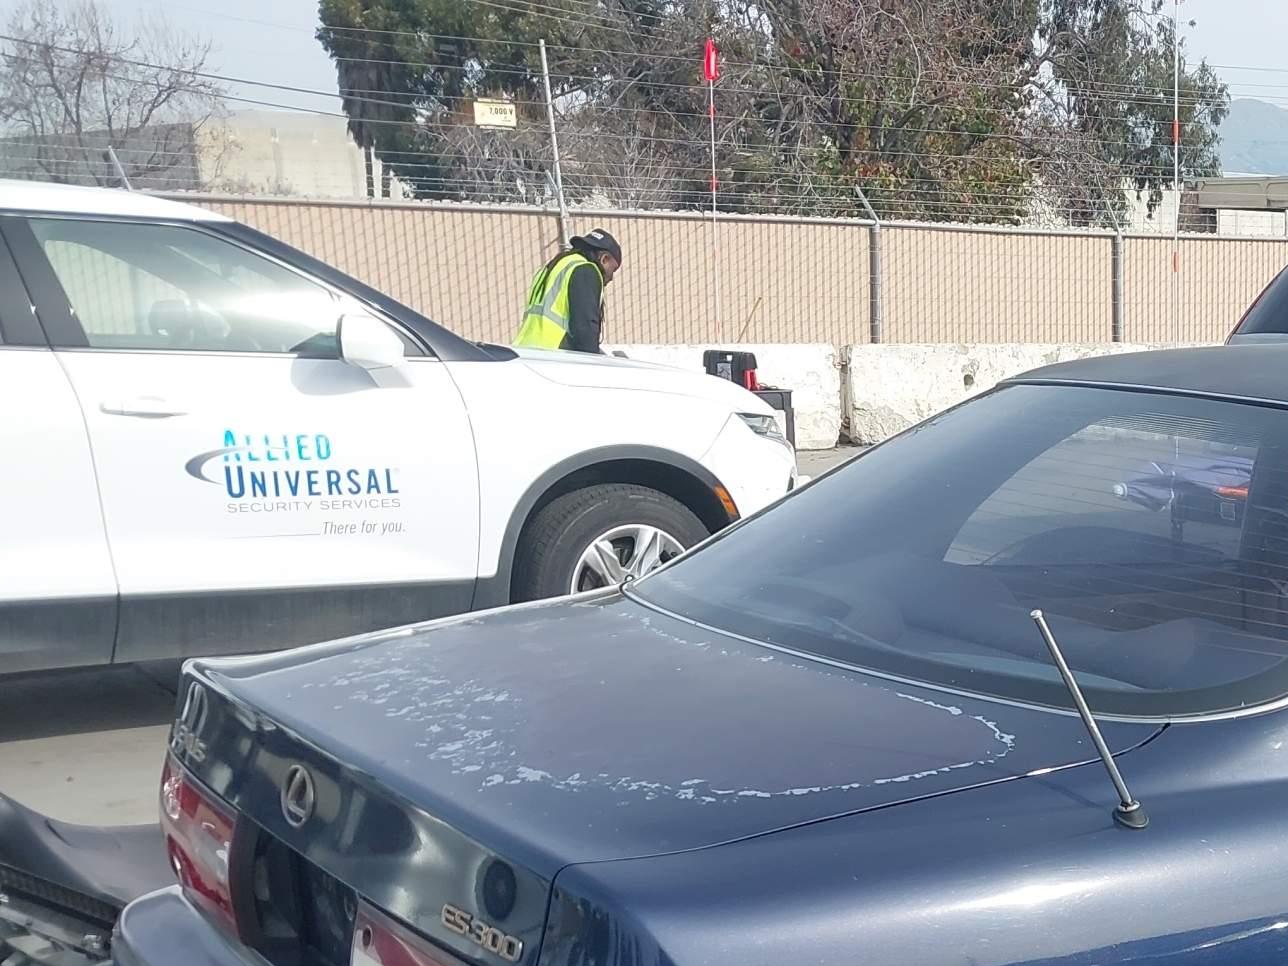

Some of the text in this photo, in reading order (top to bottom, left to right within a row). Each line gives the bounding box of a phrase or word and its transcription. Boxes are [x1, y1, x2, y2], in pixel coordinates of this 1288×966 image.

[223, 429, 332, 463] ALLIED
[224, 465, 399, 498] UNIVERSAL
[226, 498, 401, 514] SECURITY SERVICES
[322, 519, 406, 536] There for you.
